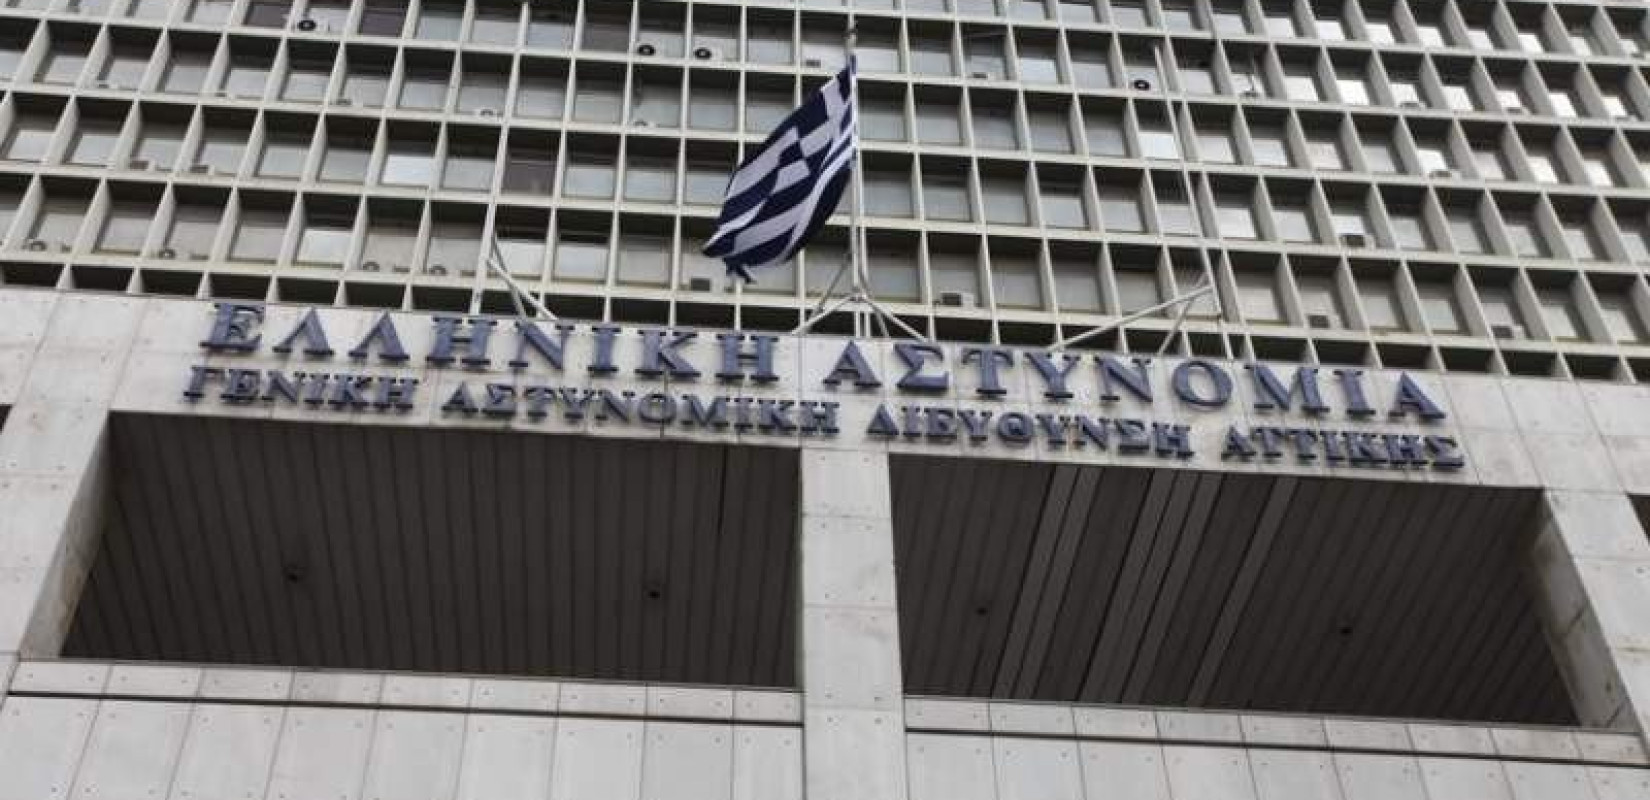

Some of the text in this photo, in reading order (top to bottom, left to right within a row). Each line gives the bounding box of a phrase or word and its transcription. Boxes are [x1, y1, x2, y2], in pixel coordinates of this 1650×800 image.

[200, 301, 1447, 419] ΕΛΛΗΝΙΚΗ ΑΣΤΥΝΟΜΙΑ
[183, 365, 1465, 468] ΓΕΝΙΚΗ ΑΣΤΥΝΟΜΙΚΗ ΔΙΕΥΘΥΝΣΗ ΑΤΤΙΚΗΣ
